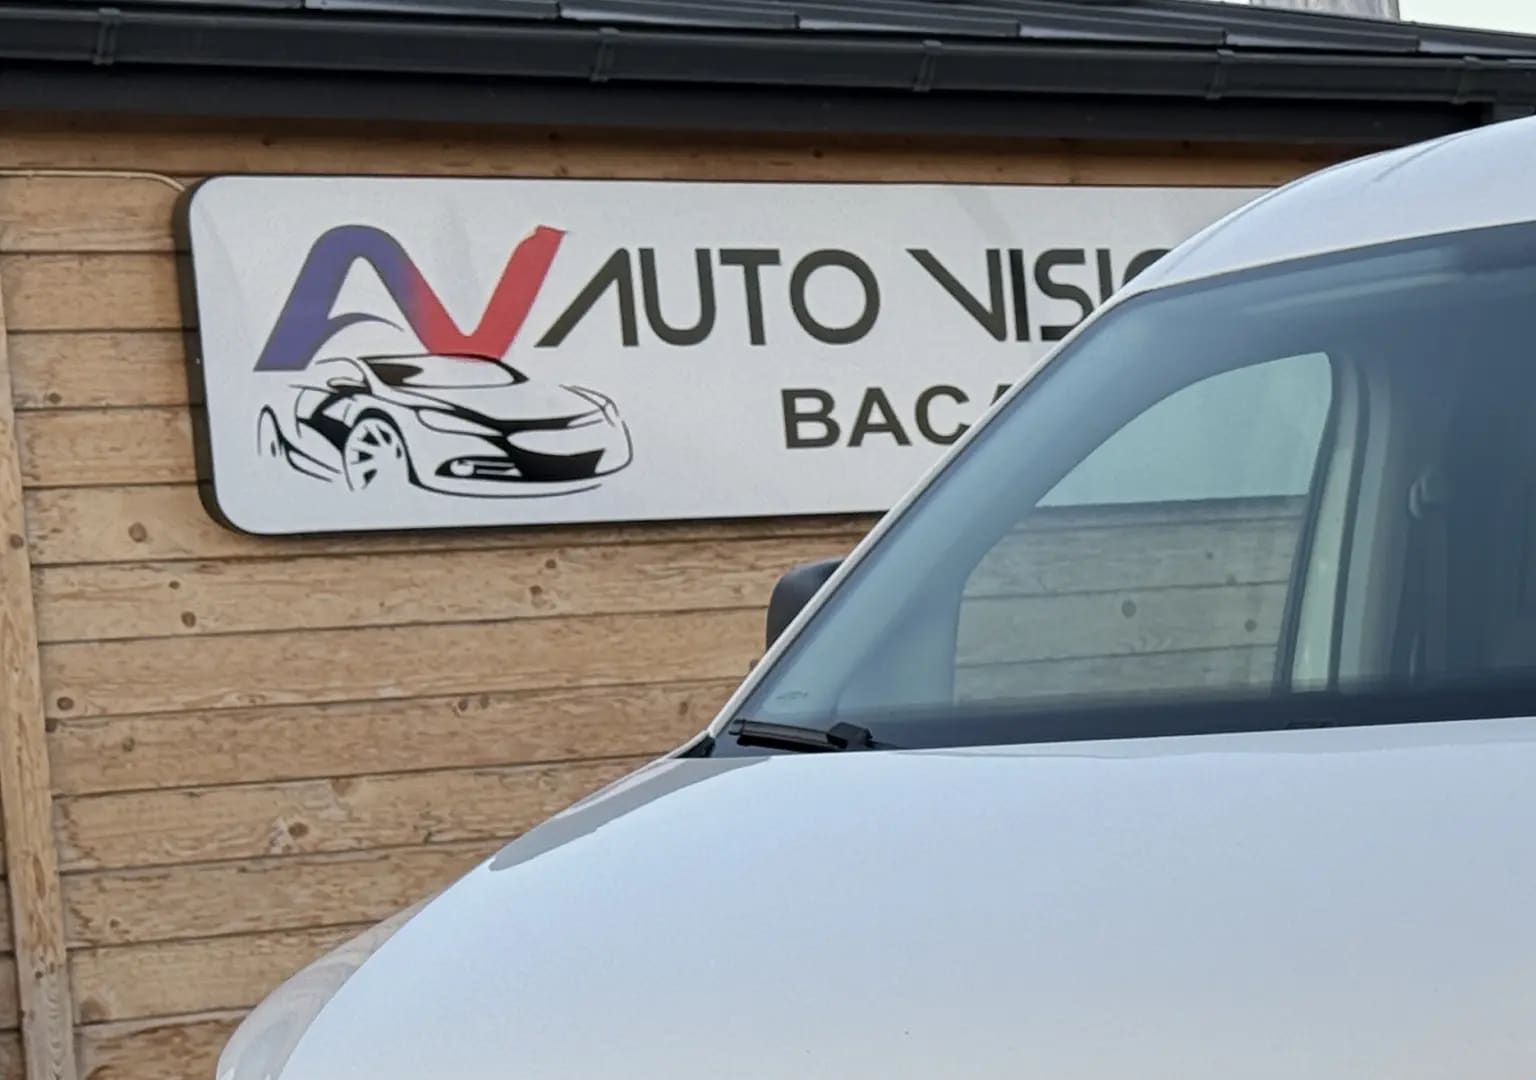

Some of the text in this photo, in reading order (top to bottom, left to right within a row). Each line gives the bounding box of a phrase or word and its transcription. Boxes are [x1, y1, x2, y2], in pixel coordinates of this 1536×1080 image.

[535, 247, 1174, 348] AUTO VISI
[782, 383, 1013, 449] BAC
